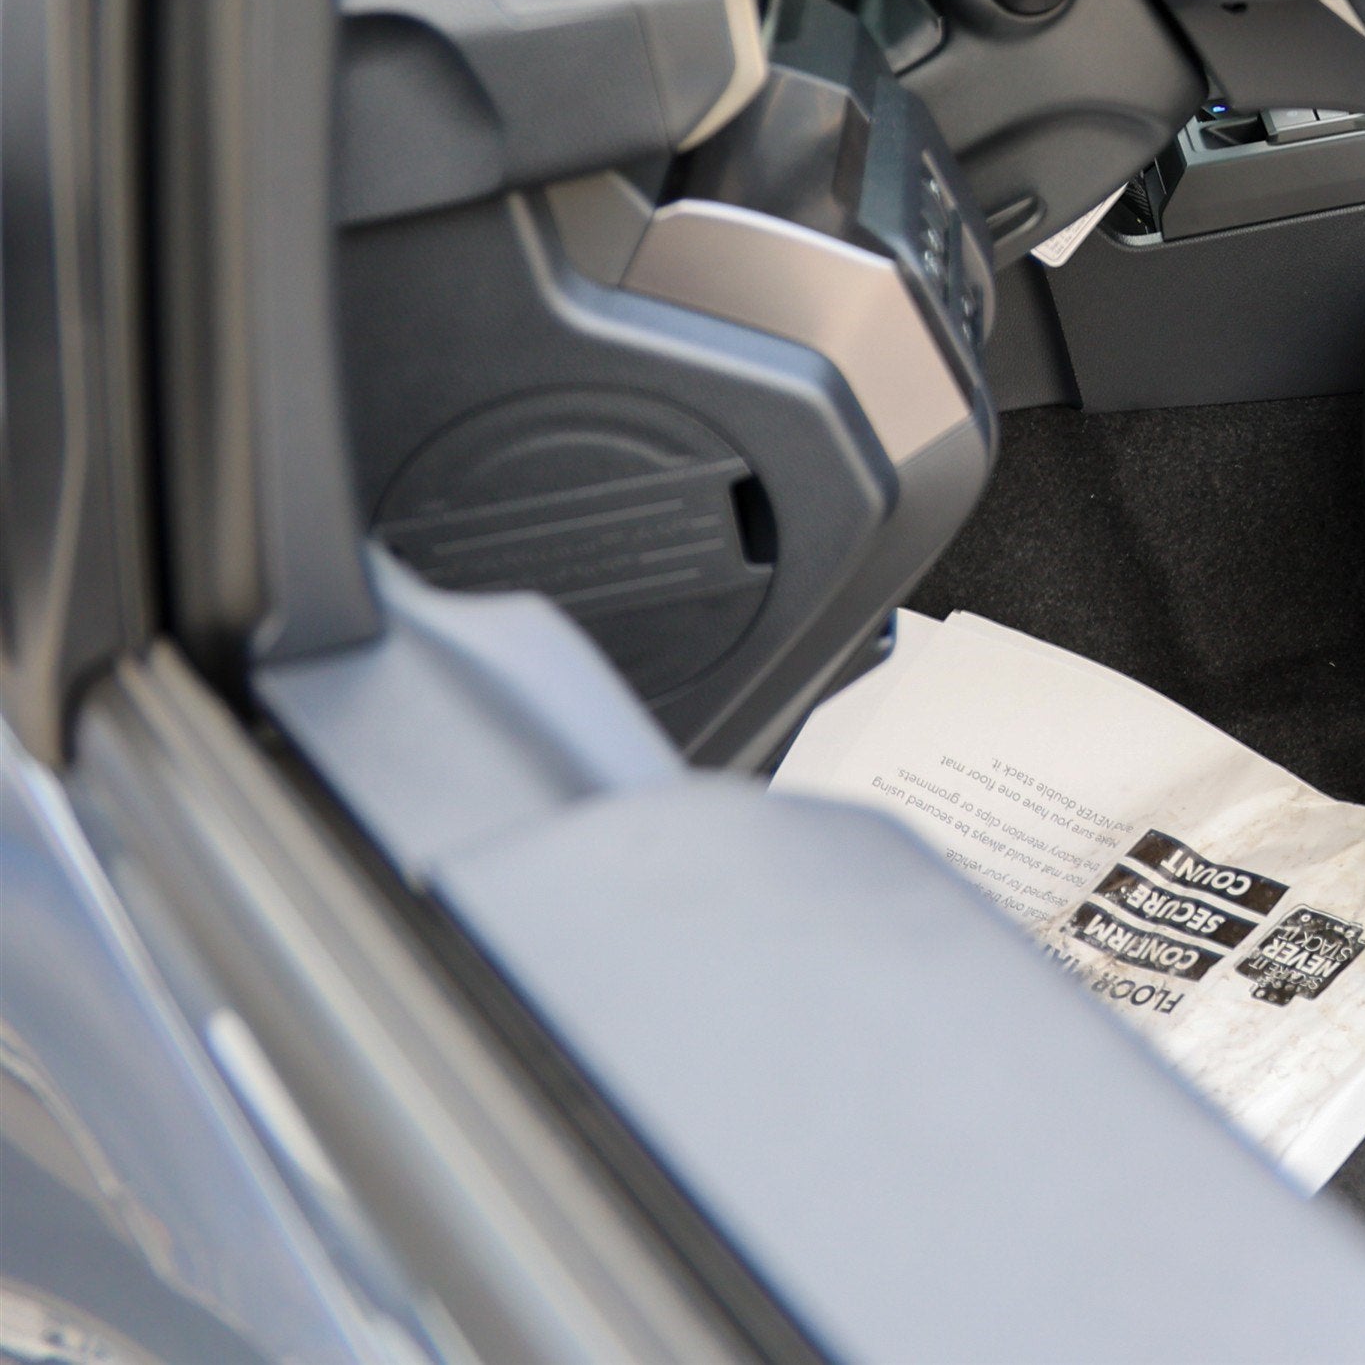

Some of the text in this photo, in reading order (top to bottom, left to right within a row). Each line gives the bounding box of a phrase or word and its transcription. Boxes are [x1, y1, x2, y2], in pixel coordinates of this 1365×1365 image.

[1002, 764, 1035, 787] stack
[938, 755, 1120, 849] Make sure you have one floor mat
[1036, 783, 1077, 811] double
[896, 767, 1100, 873] the factory retention clips or grommets.
[1076, 804, 1114, 830] NEVER
[1112, 821, 1135, 835] and
[871, 777, 1087, 888] Floor mat should always be secured using
[946, 848, 982, 873] vehicle.
[1160, 848, 1252, 896] COUNT
[981, 868, 1009, 884] your
[1005, 879, 1022, 893] for
[1020, 885, 1069, 908] designed
[1125, 883, 1226, 934] SECURE
[1083, 913, 1200, 970] CONFIRM
[1295, 931, 1353, 962] STACK
[1261, 938, 1341, 978] NEVER
[1263, 963, 1323, 990] SECURE
[1091, 971, 1185, 1015] FLOOR
